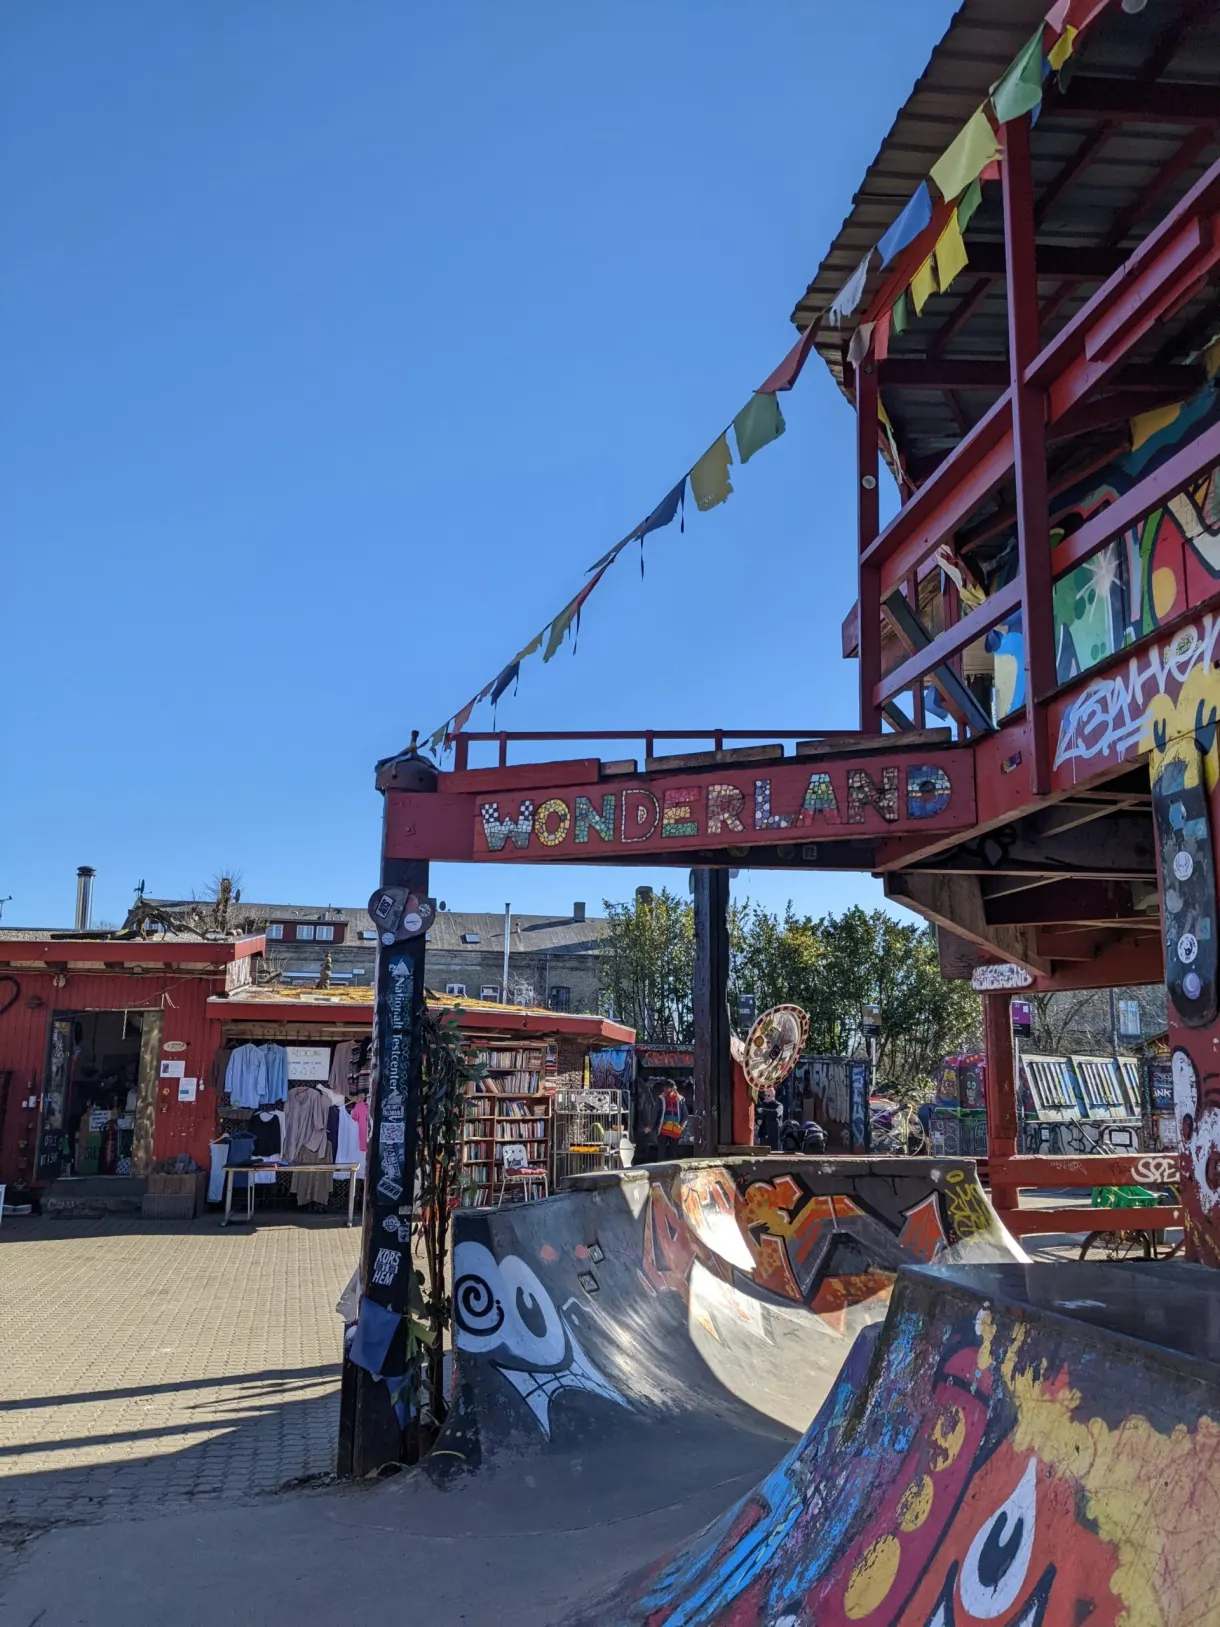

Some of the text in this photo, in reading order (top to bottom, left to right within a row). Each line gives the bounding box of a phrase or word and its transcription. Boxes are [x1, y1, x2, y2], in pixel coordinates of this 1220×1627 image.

[480, 764, 951, 852] WONDERLAND
[392, 978, 405, 1029] Nationalt
[389, 1033, 403, 1090] Testcenter
[372, 1270, 395, 1286] HEM
[376, 1249, 402, 1266] KORS
